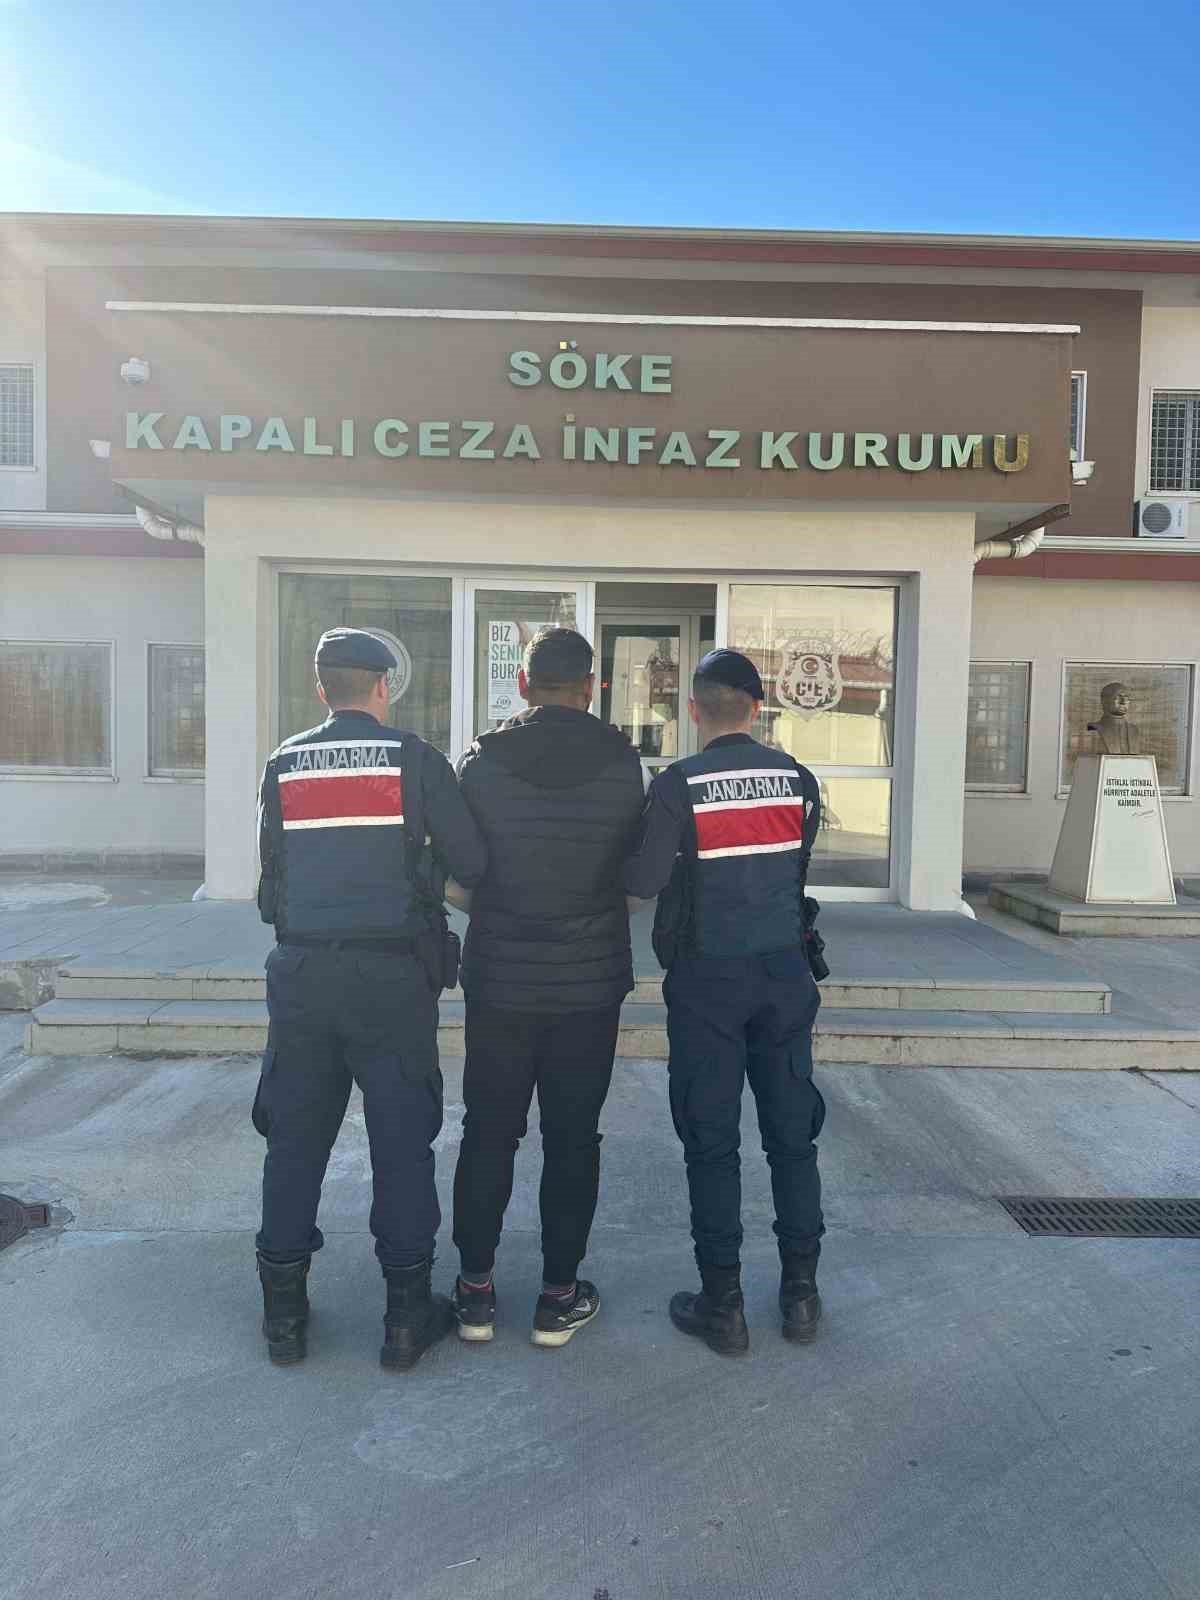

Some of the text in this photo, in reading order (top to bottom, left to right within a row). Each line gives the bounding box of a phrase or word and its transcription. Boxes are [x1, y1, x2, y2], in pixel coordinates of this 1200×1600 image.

[508, 340, 673, 393] SÖKE
[124, 411, 1030, 472] KAPALI CEZA İNFAZ KURUMU
[290, 747, 390, 771] JANDARMA
[702, 776, 794, 802] JANDARMA
